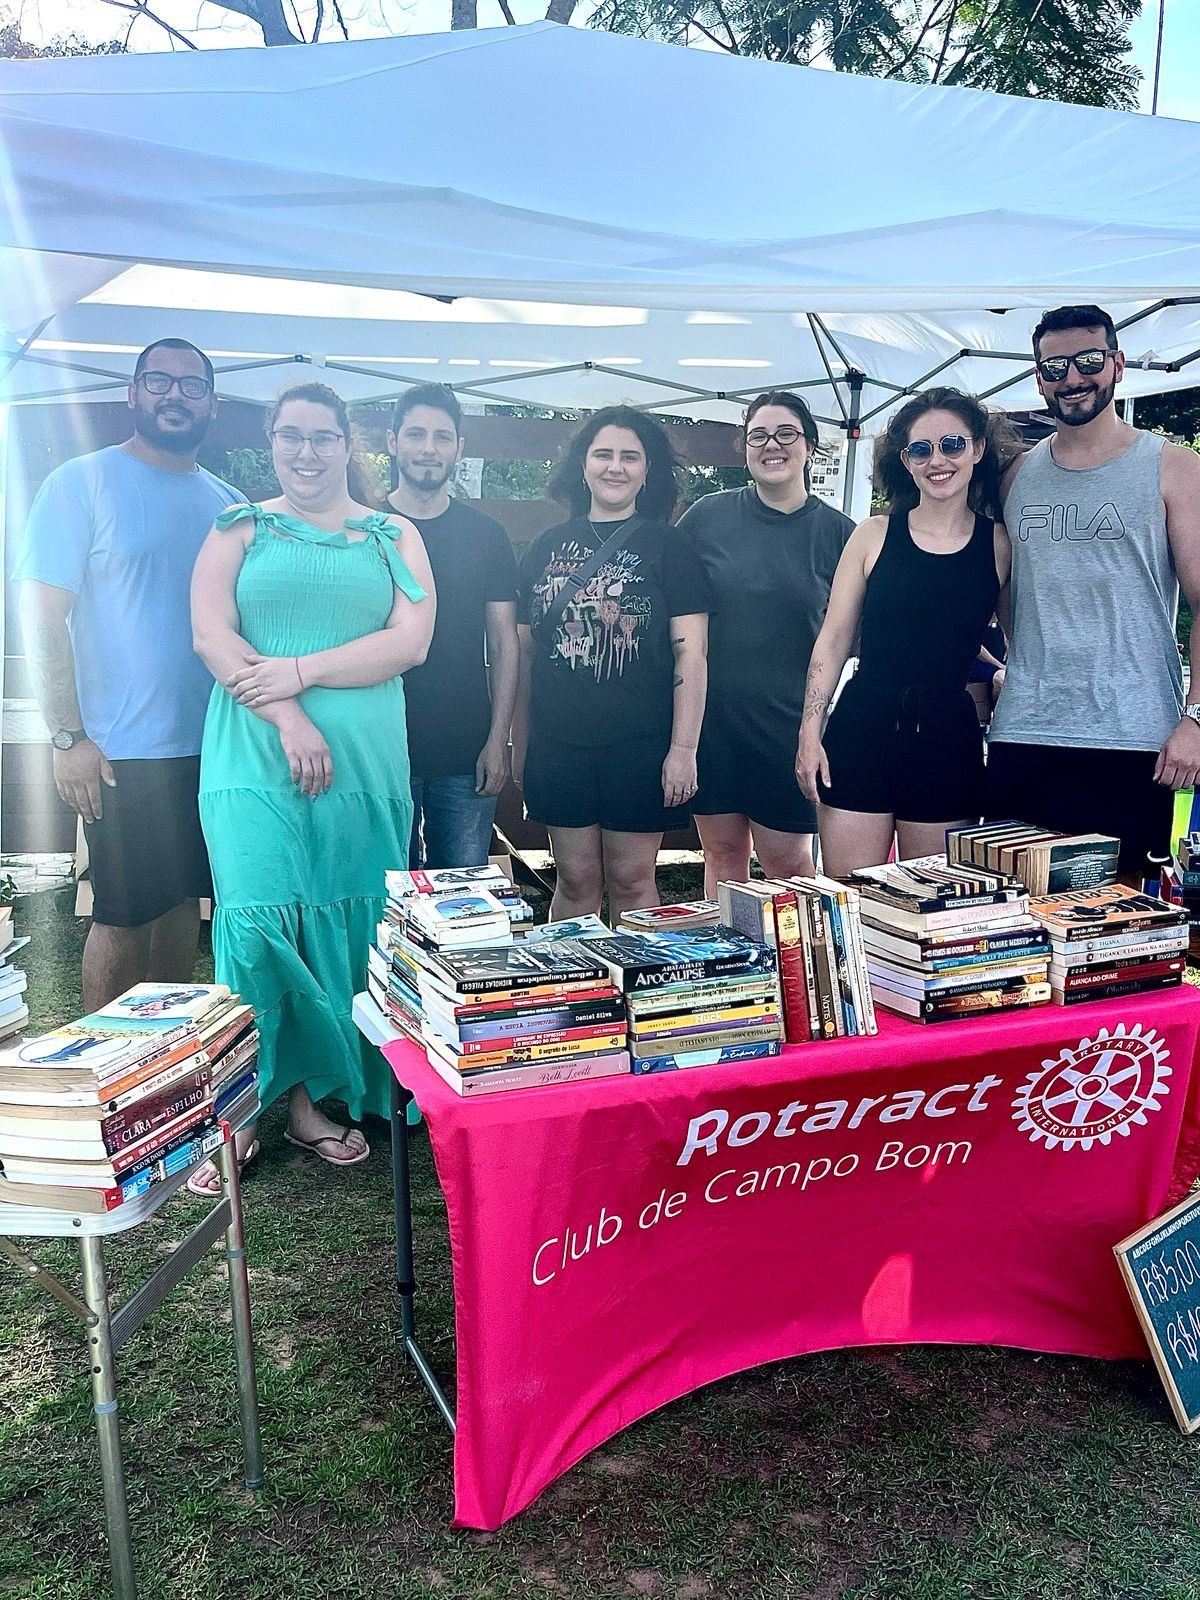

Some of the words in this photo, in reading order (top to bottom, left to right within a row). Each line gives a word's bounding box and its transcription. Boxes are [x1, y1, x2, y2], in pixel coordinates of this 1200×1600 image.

[1018, 502, 1126, 542] FILA
[1099, 938, 1121, 947] TIGANA
[1099, 950, 1121, 959] TIGANA
[665, 963, 695, 972] BATALHA
[485, 978, 513, 990] NICHOLAS
[634, 968, 706, 987] APOCALIPSE
[1070, 976, 1093, 987] ALIANÇA
[1100, 972, 1119, 982] CRIME
[462, 980, 485, 991] PILEGGI
[575, 1013, 596, 1023] Daniel
[595, 1011, 612, 1020] Silva
[694, 1012, 723, 1025] Huck
[684, 1035, 721, 1047] TESTAMENTO
[542, 1046, 562, 1056] segredo
[1079, 1040, 1145, 1058] ROTARY
[538, 1070, 562, 1084] Beth
[677, 1074, 1002, 1166] Rotaract
[1032, 1102, 1138, 1138] INTERNATIONAL
[121, 1119, 152, 1143] CLARA
[122, 1175, 149, 1197] BRASIL
[532, 1206, 622, 1288] Club
[637, 1187, 688, 1231] de
[703, 1153, 859, 1204] Campo
[875, 1136, 972, 1169] Bom
